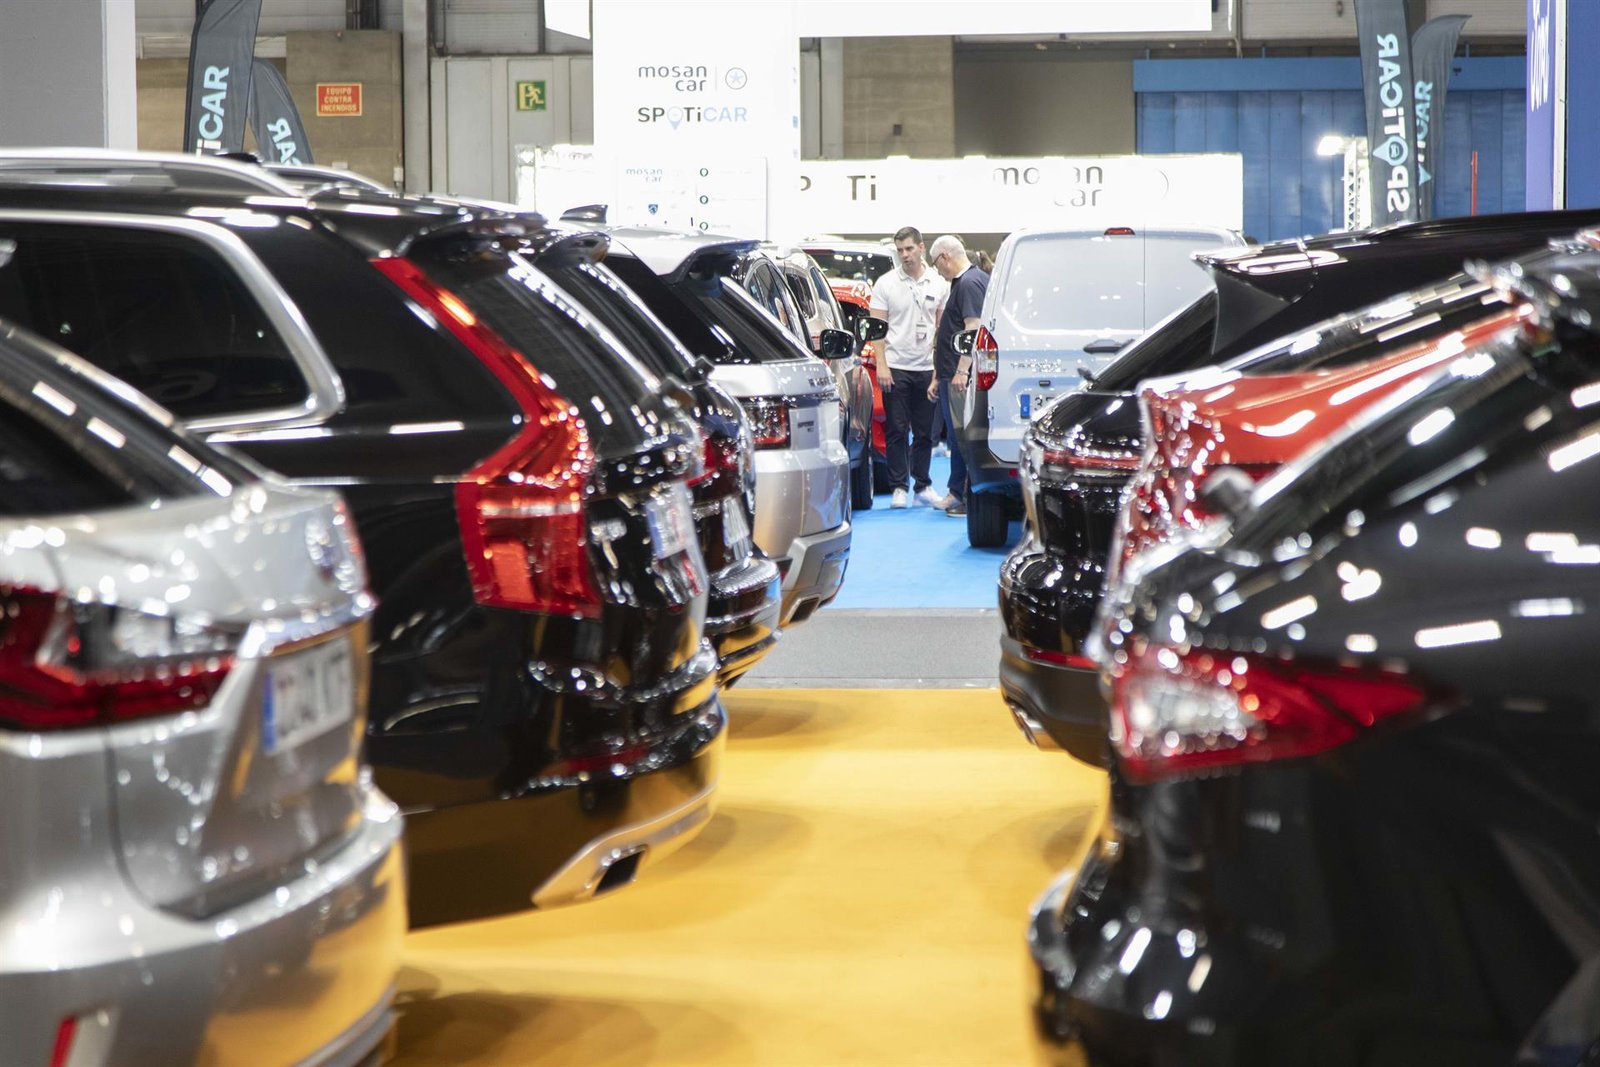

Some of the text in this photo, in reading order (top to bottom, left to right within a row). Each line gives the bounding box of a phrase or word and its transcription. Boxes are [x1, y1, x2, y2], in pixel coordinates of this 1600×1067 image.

[638, 65, 707, 78] mosan
[675, 79, 706, 91] car
[326, 87, 352, 96] EQUIPO
[324, 96, 352, 104] CONTRA
[321, 104, 357, 112] INCENDIOS
[993, 166, 1102, 185] moan
